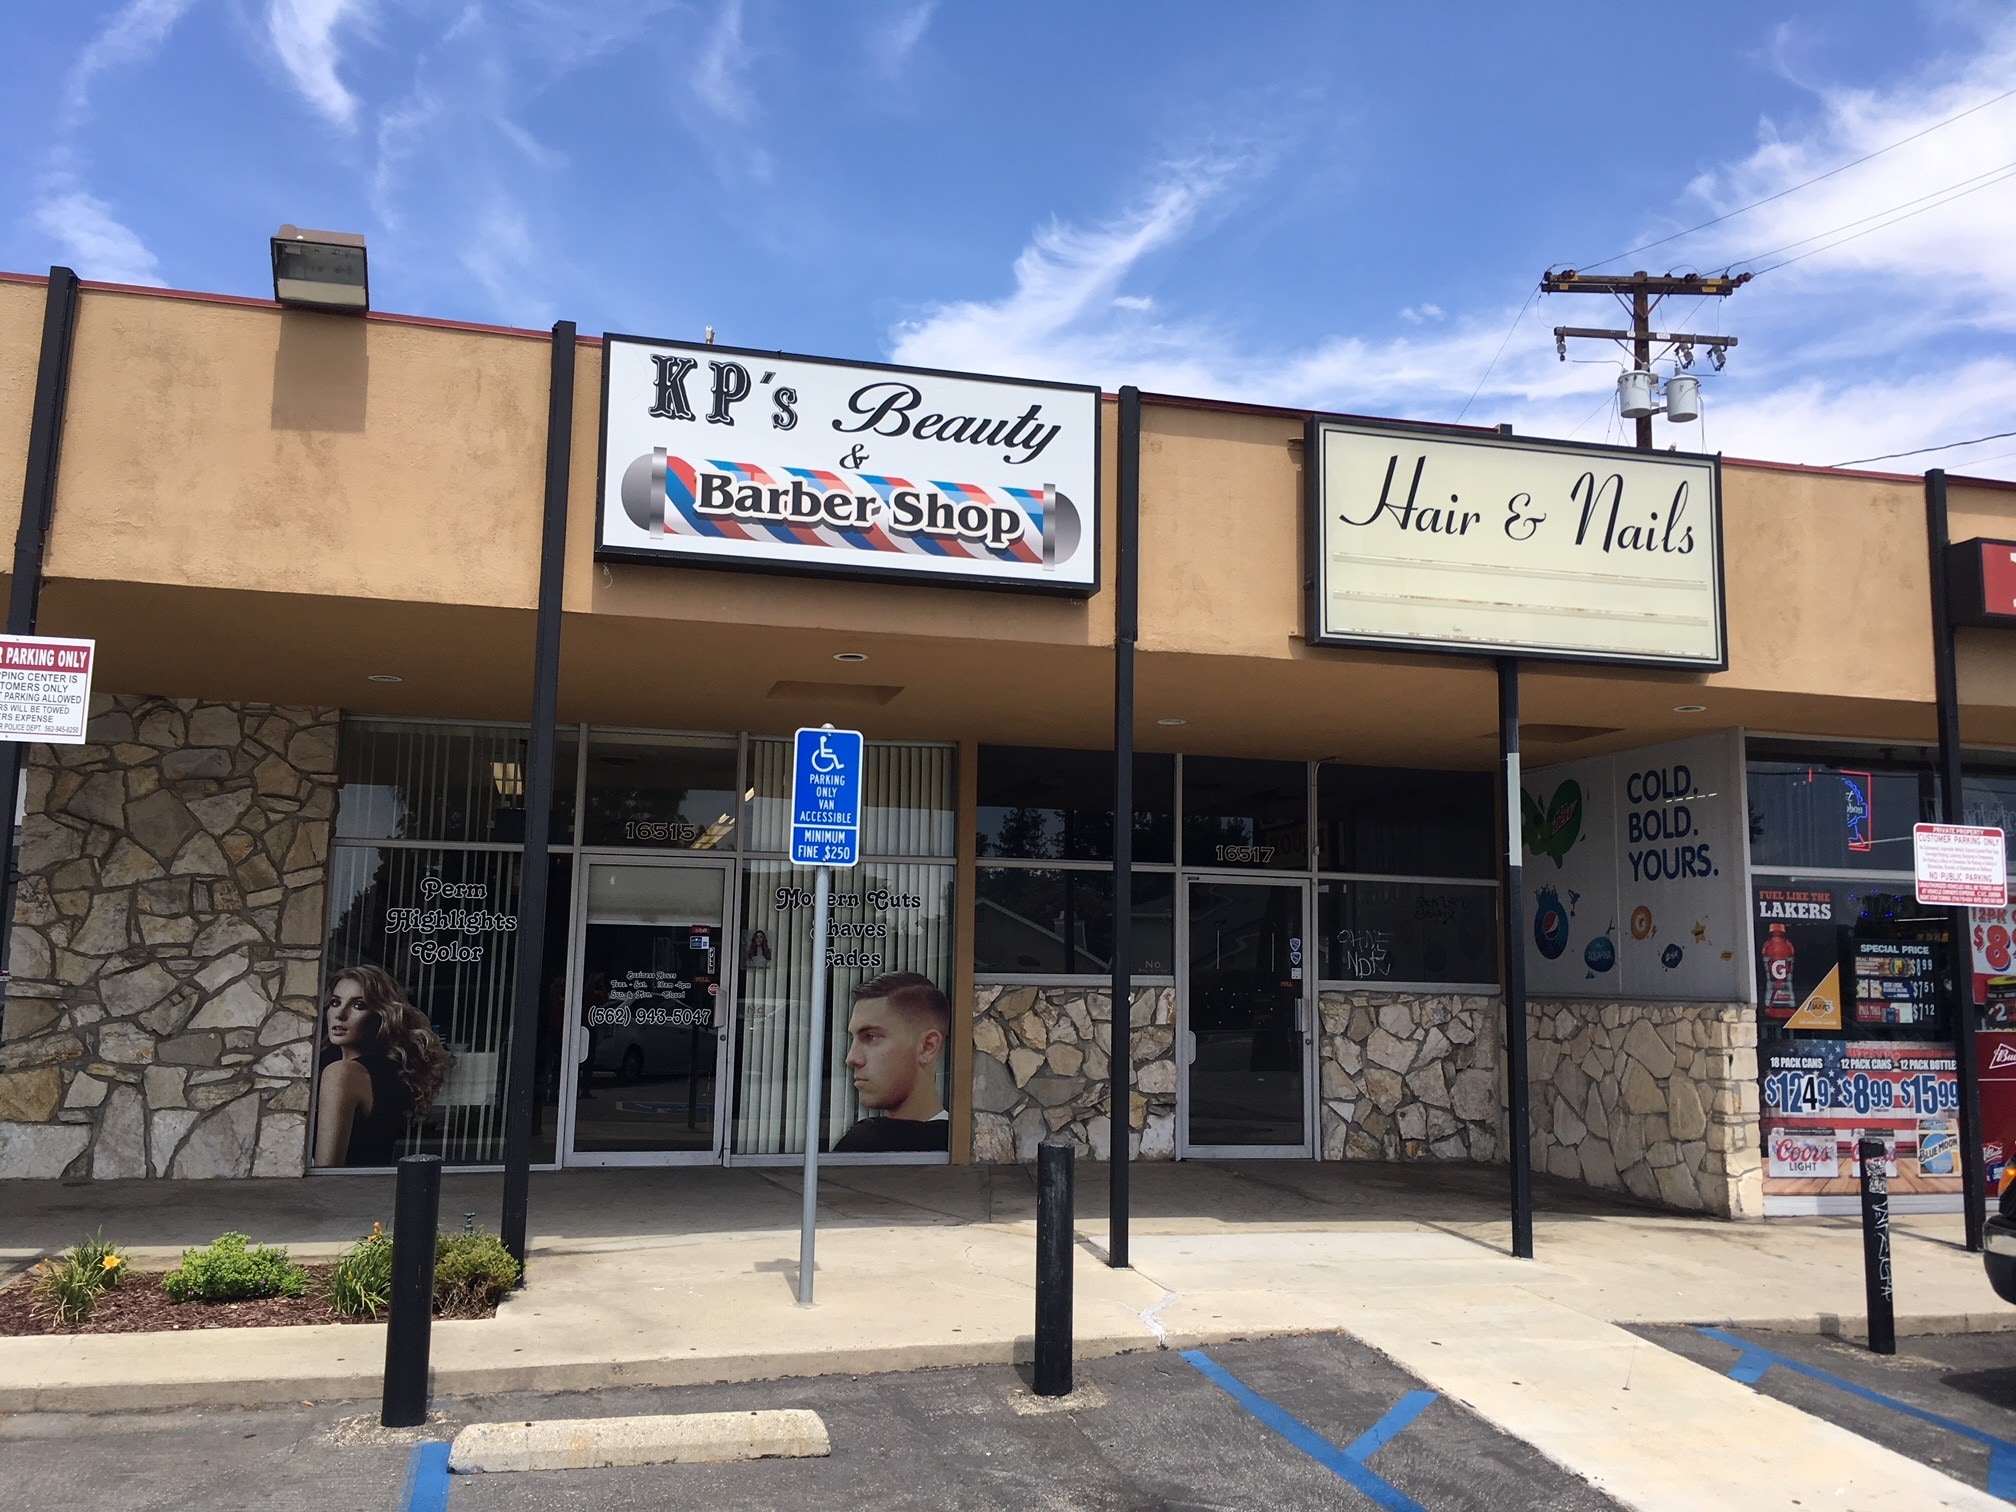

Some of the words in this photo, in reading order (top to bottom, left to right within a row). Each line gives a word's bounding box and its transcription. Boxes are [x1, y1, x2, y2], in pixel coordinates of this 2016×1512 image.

[832, 381, 1062, 465] Beauty
[839, 443, 870, 470] &
[699, 472, 880, 525] Barber
[893, 492, 1021, 544] Shop
[1339, 454, 1481, 536] Hair
[1504, 492, 1547, 541] &
[1570, 471, 1695, 554] Nails
[6, 647, 55, 666] PARKING
[58, 650, 88, 669] ONLY
[27, 673, 66, 683] CENTER
[69, 675, 78, 683] IS
[43, 684, 69, 693] ONLY
[4, 692, 40, 702] PARKING
[42, 694, 82, 704] ALLOWED
[15, 714, 53, 723] EXPENSE
[43, 707, 70, 715] TOWED
[810, 774, 846, 786] PARKING
[1627, 765, 1698, 804] COLD.
[816, 787, 837, 798] ONLY
[819, 799, 834, 810] VAN
[800, 811, 852, 823] ACCESSIBLE
[1629, 805, 1698, 843] BOLD.
[626, 822, 696, 840] 16515
[804, 829, 846, 844] MINIMUM
[1919, 834, 1951, 843] CUSTOMER
[1954, 837, 1981, 846] PARKING
[1984, 838, 1999, 846] ONLY
[798, 845, 819, 858] FINE
[825, 845, 850, 860] $250
[1216, 844, 1275, 863] 16517
[1629, 843, 1719, 882] YOURS.
[1929, 872, 1938, 880] NO
[1941, 872, 1963, 881] PUBLIC
[1965, 873, 1993, 883] PARKING
[421, 877, 487, 901] Perm
[1760, 890, 1784, 900] FUEL
[1787, 891, 1808, 901] LIKE
[1811, 892, 1831, 902] THE
[776, 886, 860, 910] Moern
[867, 889, 922, 911] Cuts
[1760, 901, 1831, 920] LAKERS
[385, 908, 517, 935] Highlights
[811, 917, 887, 940] haves
[410, 940, 483, 965] Color
[1860, 944, 1900, 954] SPECIAL
[1902, 946, 1930, 955] PRICE
[1771, 960, 1787, 980] G
[588, 1005, 631, 1026] (562)
[636, 1007, 711, 1026] 943-5047
[1770, 1057, 1780, 1068] 18
[1780, 1057, 1801, 1068] PACK
[1802, 1058, 1823, 1069] CANS
[1841, 1058, 1850, 1069] 12
[1850, 1059, 1871, 1069] PACK
[1871, 1059, 1892, 1070] CANS
[1900, 1060, 1908, 1070] 12
[1909, 1060, 1930, 1070] PACK
[1842, 1074, 1893, 1114] $899
[1776, 1139, 1832, 1162] Coors
[1789, 1162, 1817, 1171] LIGHT
